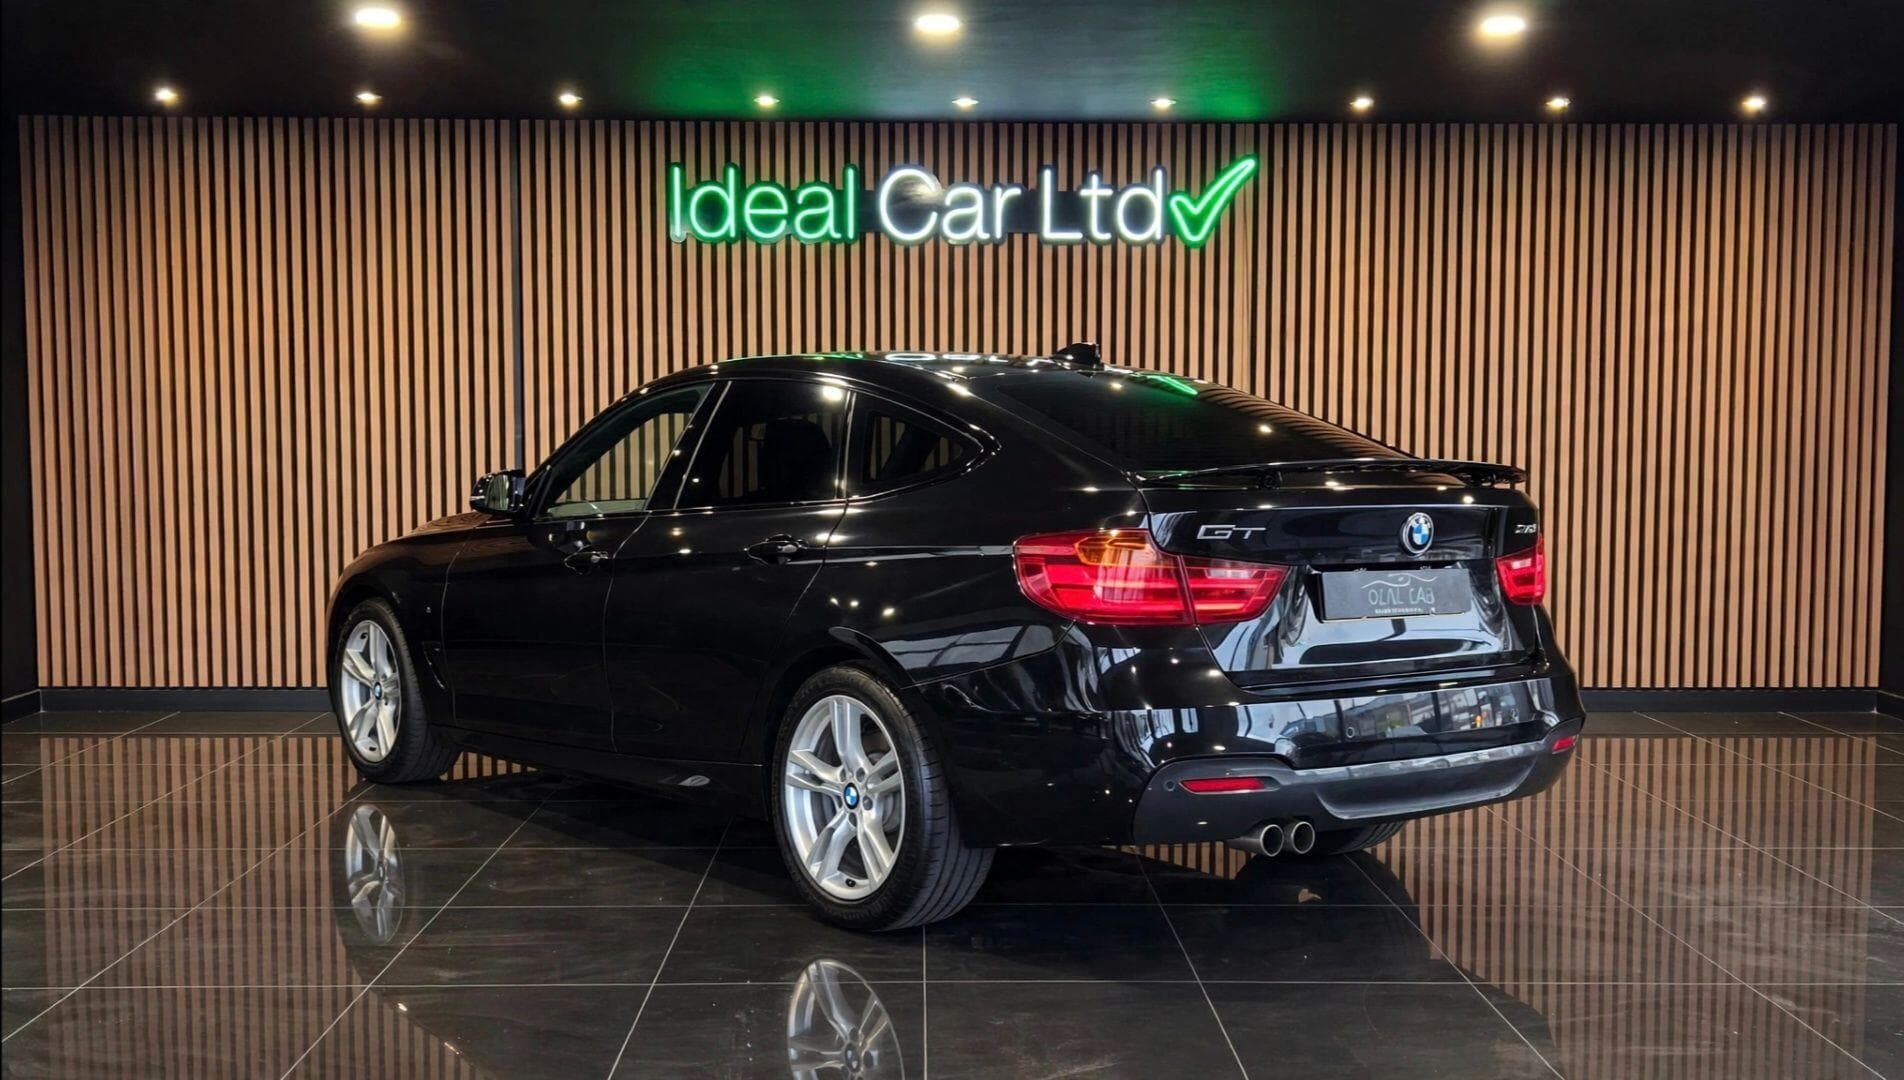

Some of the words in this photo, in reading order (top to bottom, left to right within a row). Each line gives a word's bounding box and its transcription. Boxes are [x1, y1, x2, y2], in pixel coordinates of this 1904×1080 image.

[670, 164, 858, 243] Ideal
[877, 165, 1020, 244] Car
[1038, 165, 1169, 243] Ltd
[1196, 524, 1267, 539] GT
